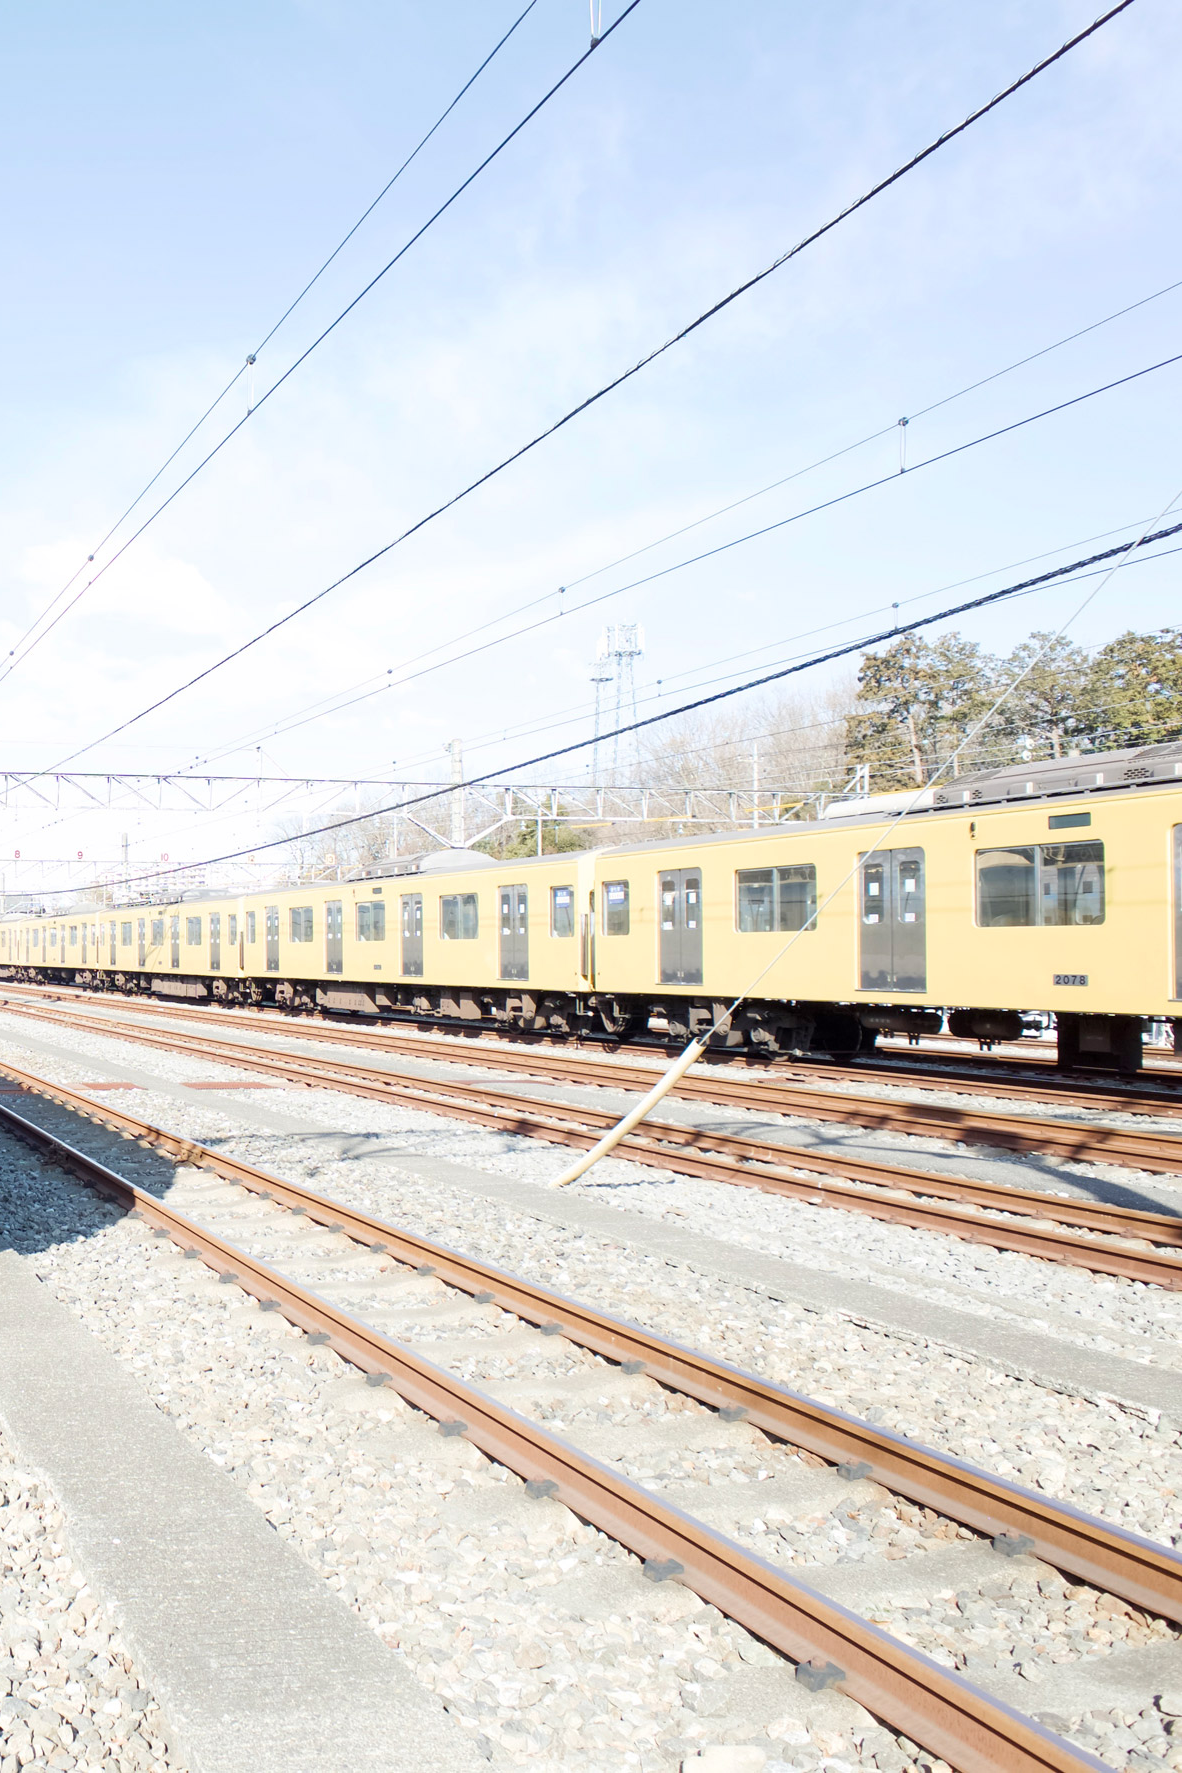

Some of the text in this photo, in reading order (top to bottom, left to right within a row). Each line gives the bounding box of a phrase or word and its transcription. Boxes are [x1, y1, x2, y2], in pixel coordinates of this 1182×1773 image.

[14, 850, 21, 858] 8
[77, 851, 83, 860] 9
[160, 853, 169, 862] 10
[1055, 975, 1086, 985] 2078
